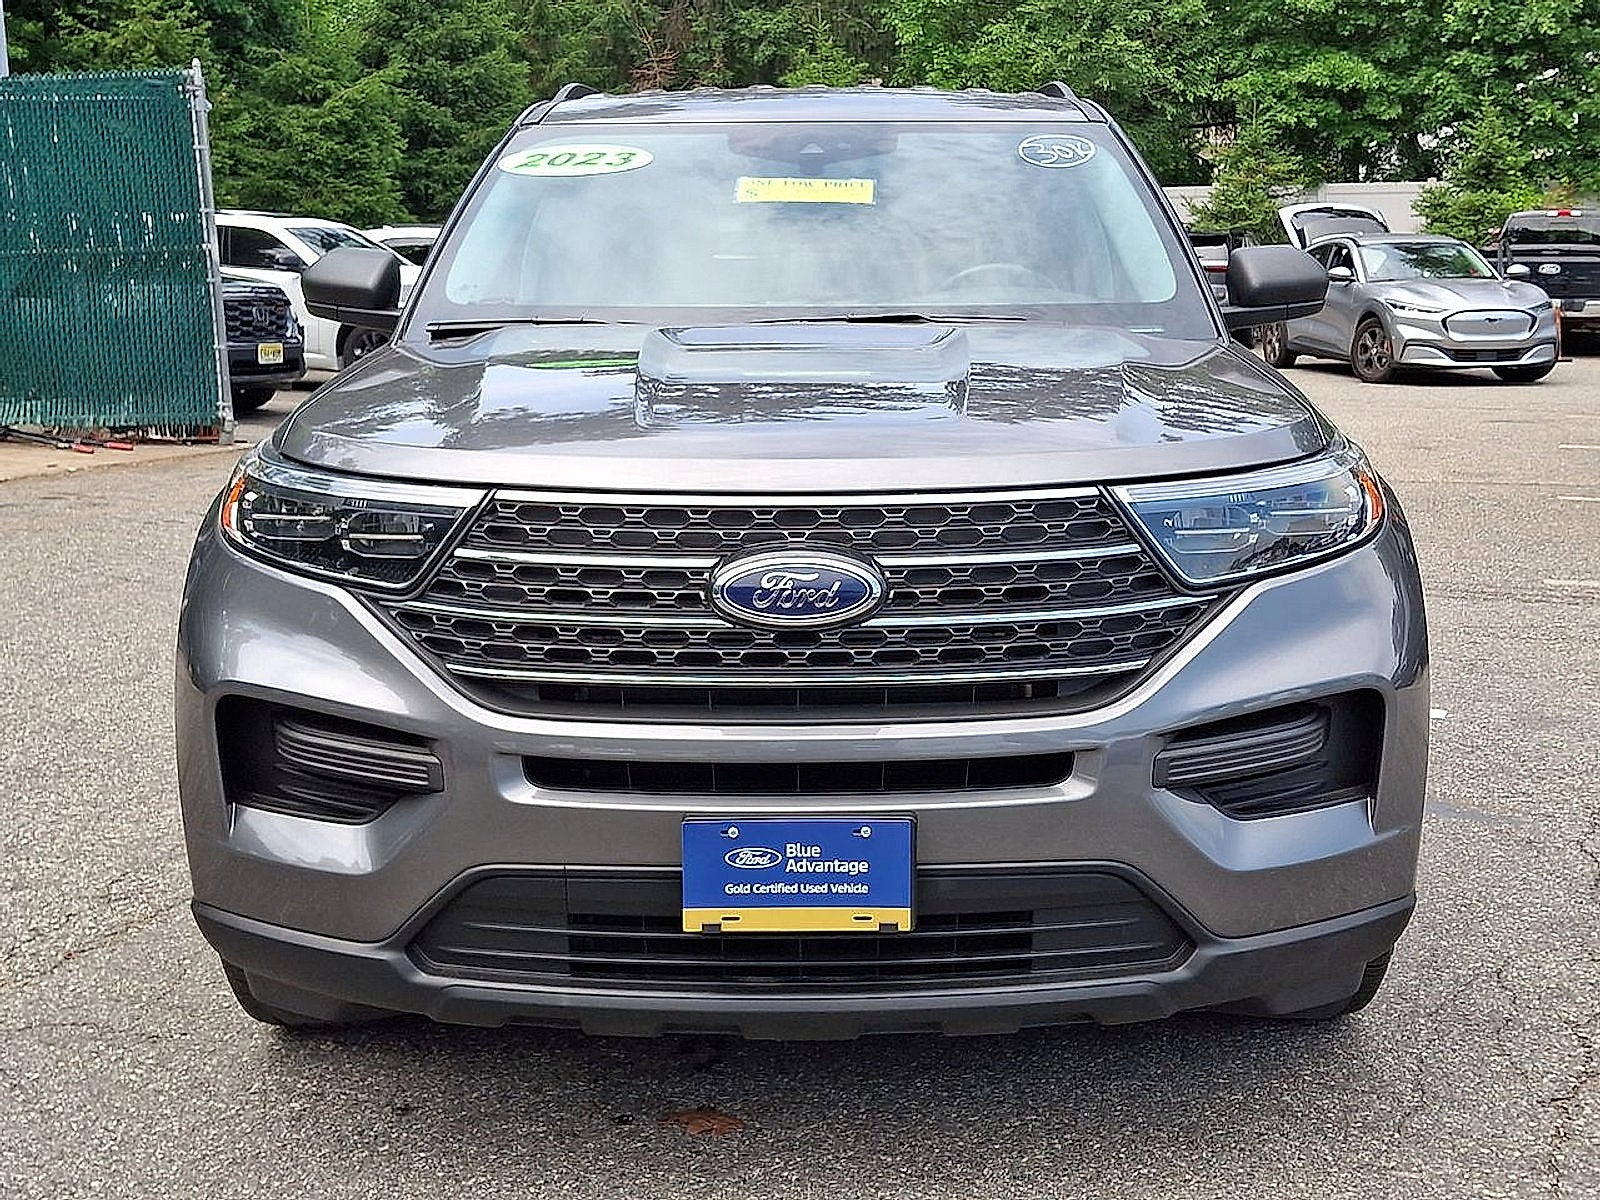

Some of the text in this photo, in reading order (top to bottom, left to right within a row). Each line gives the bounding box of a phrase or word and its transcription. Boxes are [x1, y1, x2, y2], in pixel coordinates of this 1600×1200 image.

[512, 152, 637, 169] 2023
[753, 571, 843, 609] Ford
[734, 849, 772, 866] Ford
[786, 842, 822, 858] Blue
[785, 858, 869, 876] Advantage
[724, 883, 869, 895] Gold Certified Used Vehicle
